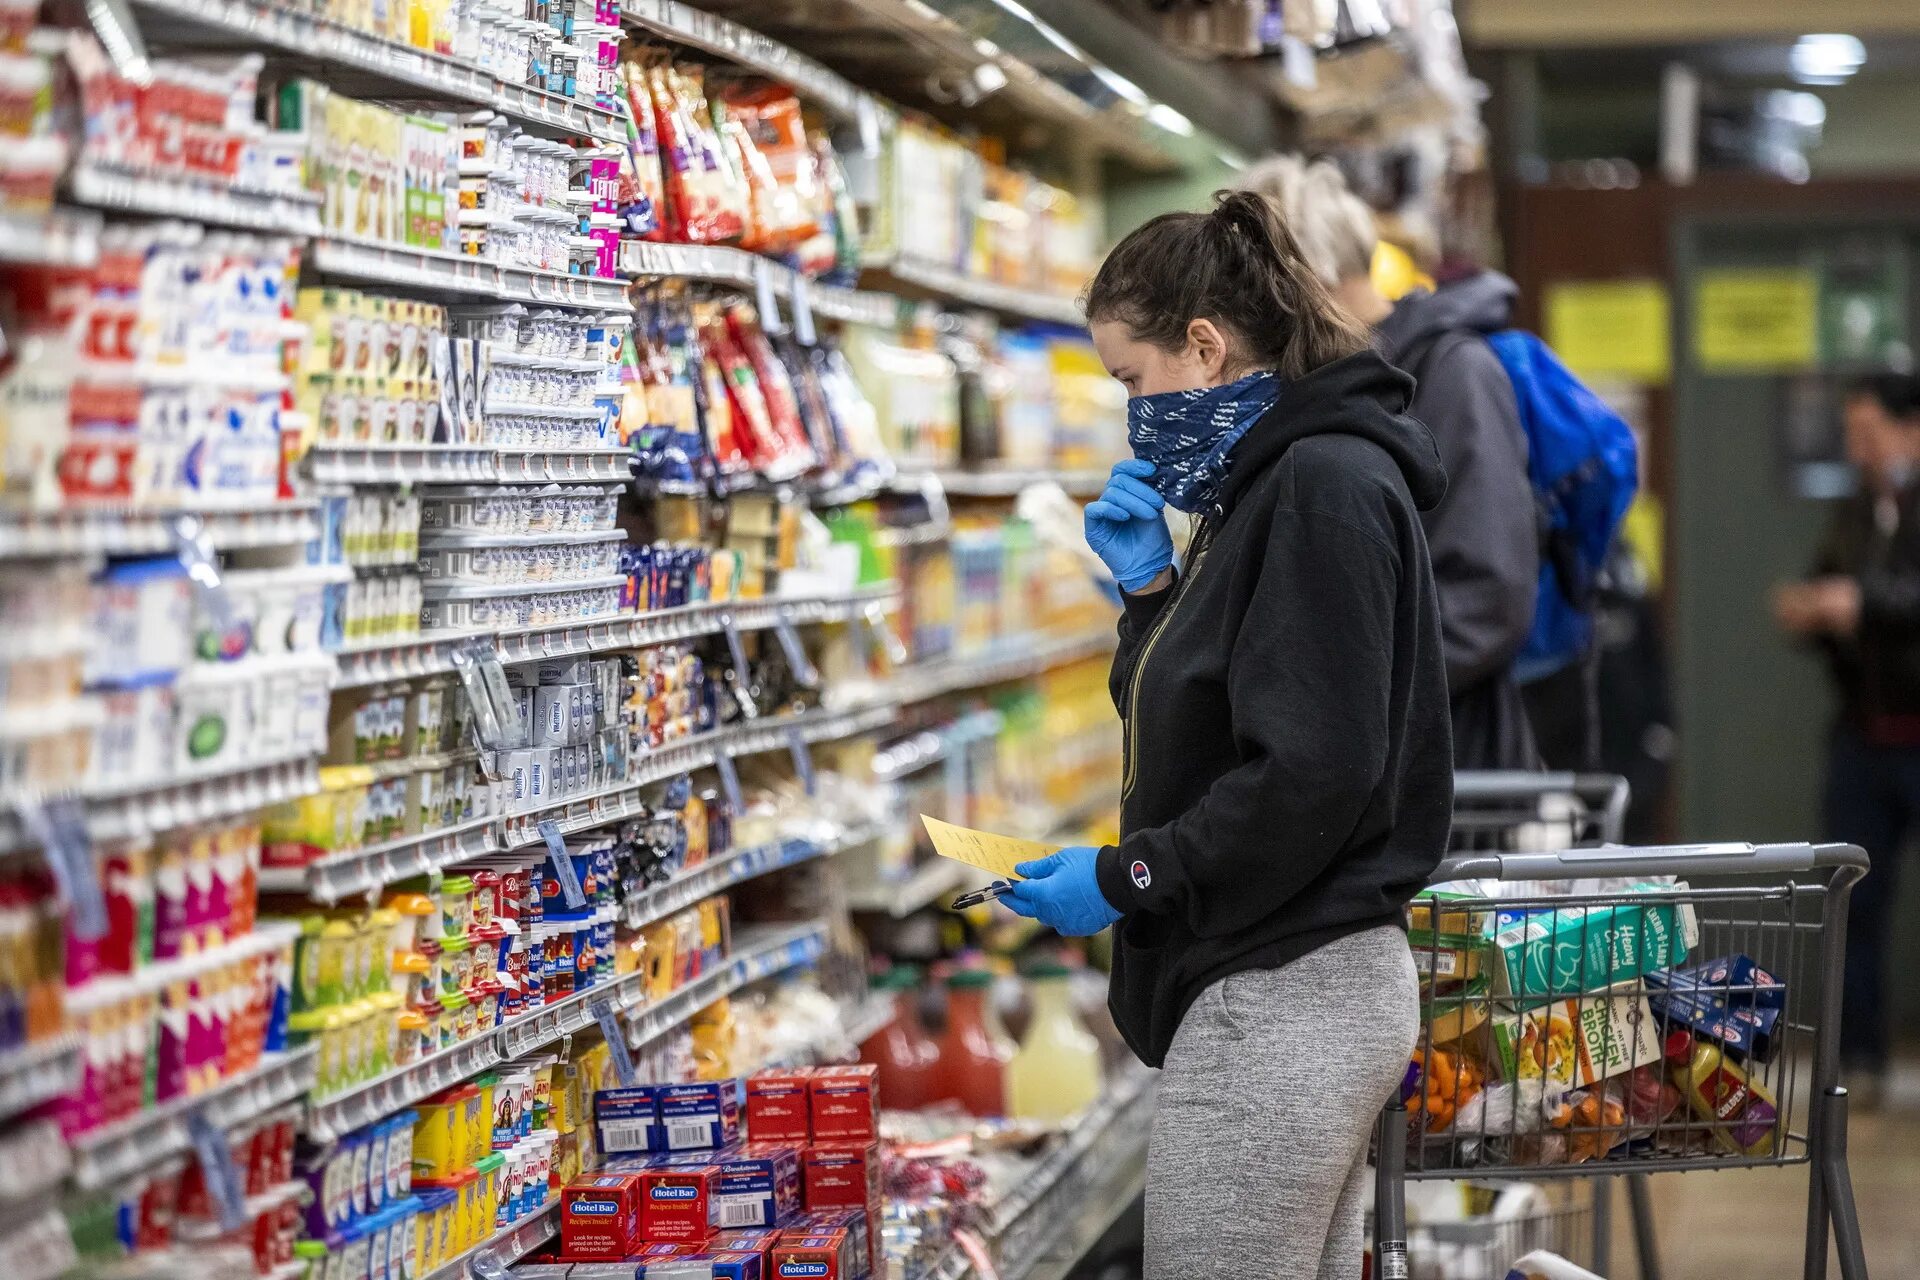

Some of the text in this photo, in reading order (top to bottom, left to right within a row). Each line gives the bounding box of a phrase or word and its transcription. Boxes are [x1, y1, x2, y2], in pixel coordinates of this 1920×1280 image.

[515, 767, 523, 800] PHILADELPHIA
[1620, 924, 1636, 966] Heavy
[1581, 1008, 1606, 1066] BROTH
[1594, 996, 1622, 1069] CHICKEN
[1616, 1030, 1624, 1040] FAT
[1620, 1041, 1630, 1061] FREE
[569, 1218, 592, 1227] Recipes
[574, 1204, 615, 1212] Hotel Bar
[649, 1203, 671, 1211] Recipes
[784, 1265, 825, 1273] Hotel Bar
